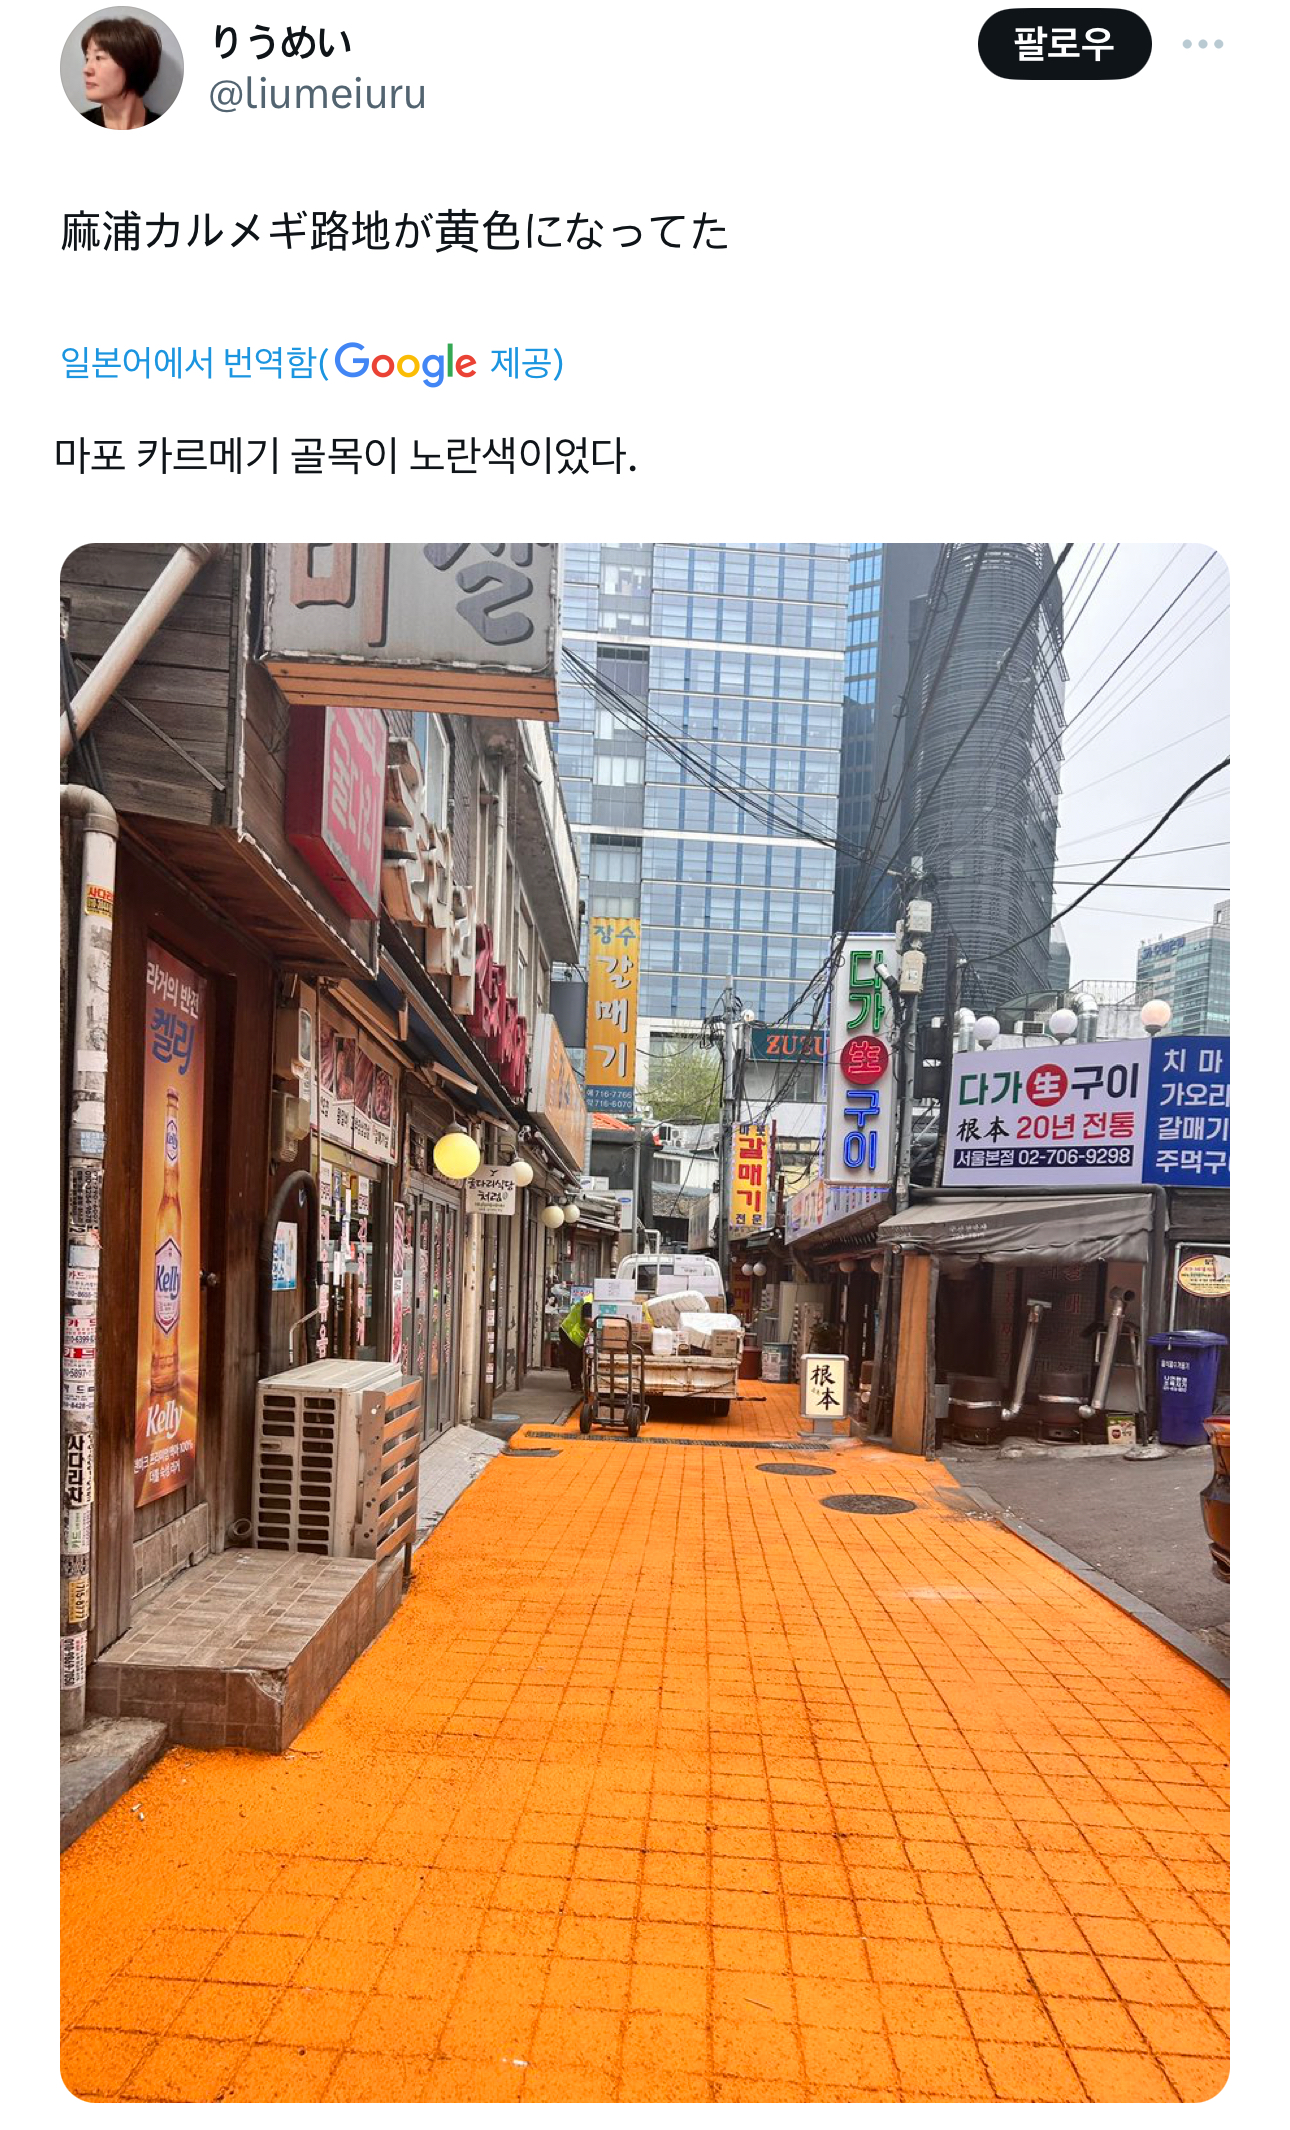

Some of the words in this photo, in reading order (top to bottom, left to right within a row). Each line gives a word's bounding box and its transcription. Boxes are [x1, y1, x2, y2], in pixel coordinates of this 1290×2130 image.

[593, 924, 637, 947] 장수
[146, 961, 179, 1007] 라거의
[592, 954, 634, 1078] 갈매기
[150, 1007, 195, 1075] 켈리
[956, 1115, 1009, 1143] 根本
[1016, 1113, 1075, 1140] 20년
[1082, 1111, 1135, 1139] 전통
[1158, 1116, 1229, 1142] 갈매기
[736, 1137, 767, 1213] 갈매기
[956, 1149, 1015, 1167] 서울본점
[1018, 1148, 1131, 1166] 02-706-9298
[1156, 1149, 1230, 1175] 주먹구
[735, 1213, 763, 1225] 전문
[155, 1265, 179, 1300] Kelly
[810, 1364, 841, 1411] 根本
[146, 1400, 183, 1439] Kelly
[67, 1435, 84, 1503] 사다리차
